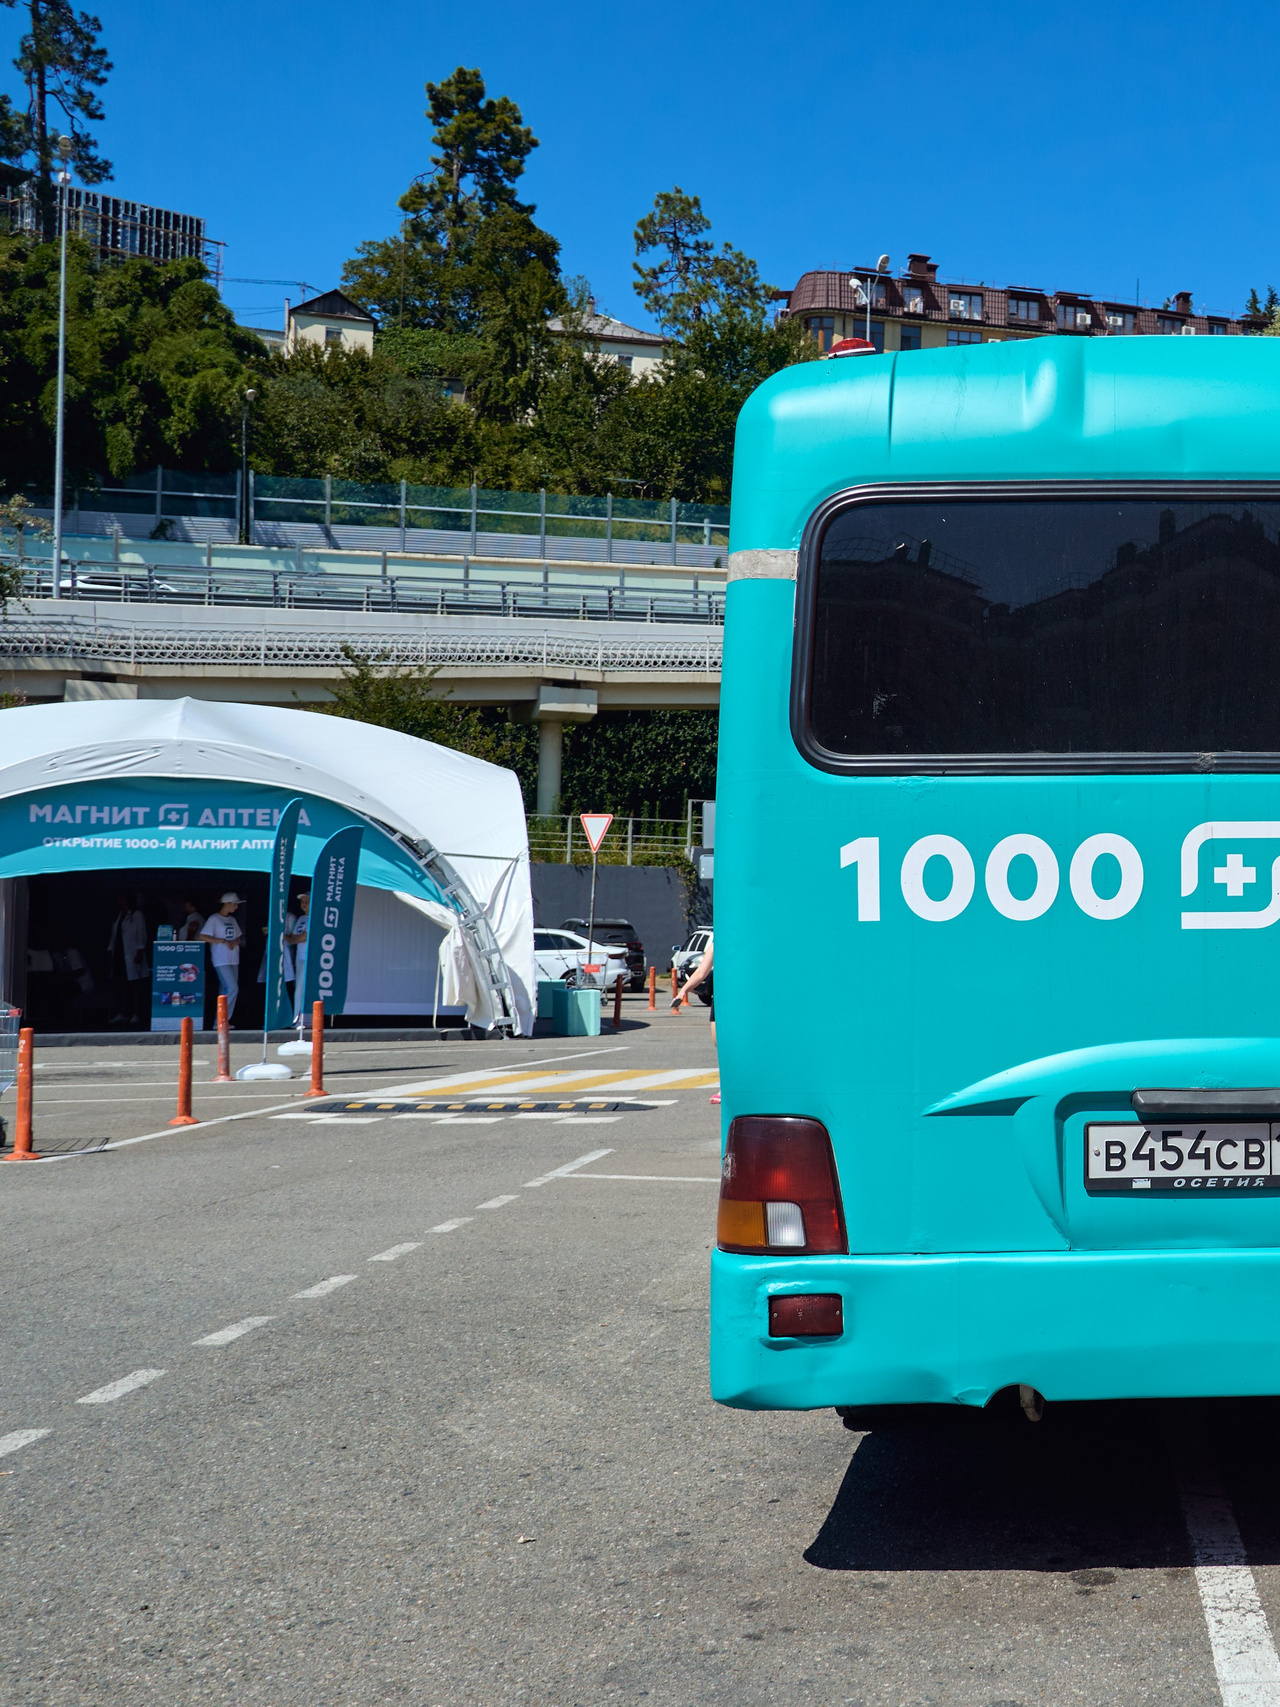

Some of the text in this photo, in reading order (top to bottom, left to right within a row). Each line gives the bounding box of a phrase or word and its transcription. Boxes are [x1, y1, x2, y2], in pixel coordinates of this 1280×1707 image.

[29, 804, 150, 825] МАГНИТ
[43, 836, 123, 849] ОТКРЫТИЕ
[125, 836, 176, 850] 1000-Й
[181, 838, 240, 849] МАГНИТ
[279, 837, 288, 893] МАГНИТ
[325, 856, 337, 902] МАГНИТ
[335, 857, 346, 902] АПТЕКА
[839, 833, 1145, 922] 1000
[318, 933, 336, 1001] 1000
[1104, 1129, 1266, 1172] В454СВ
[1173, 1177, 1266, 1188] ОСЕТИЯ
